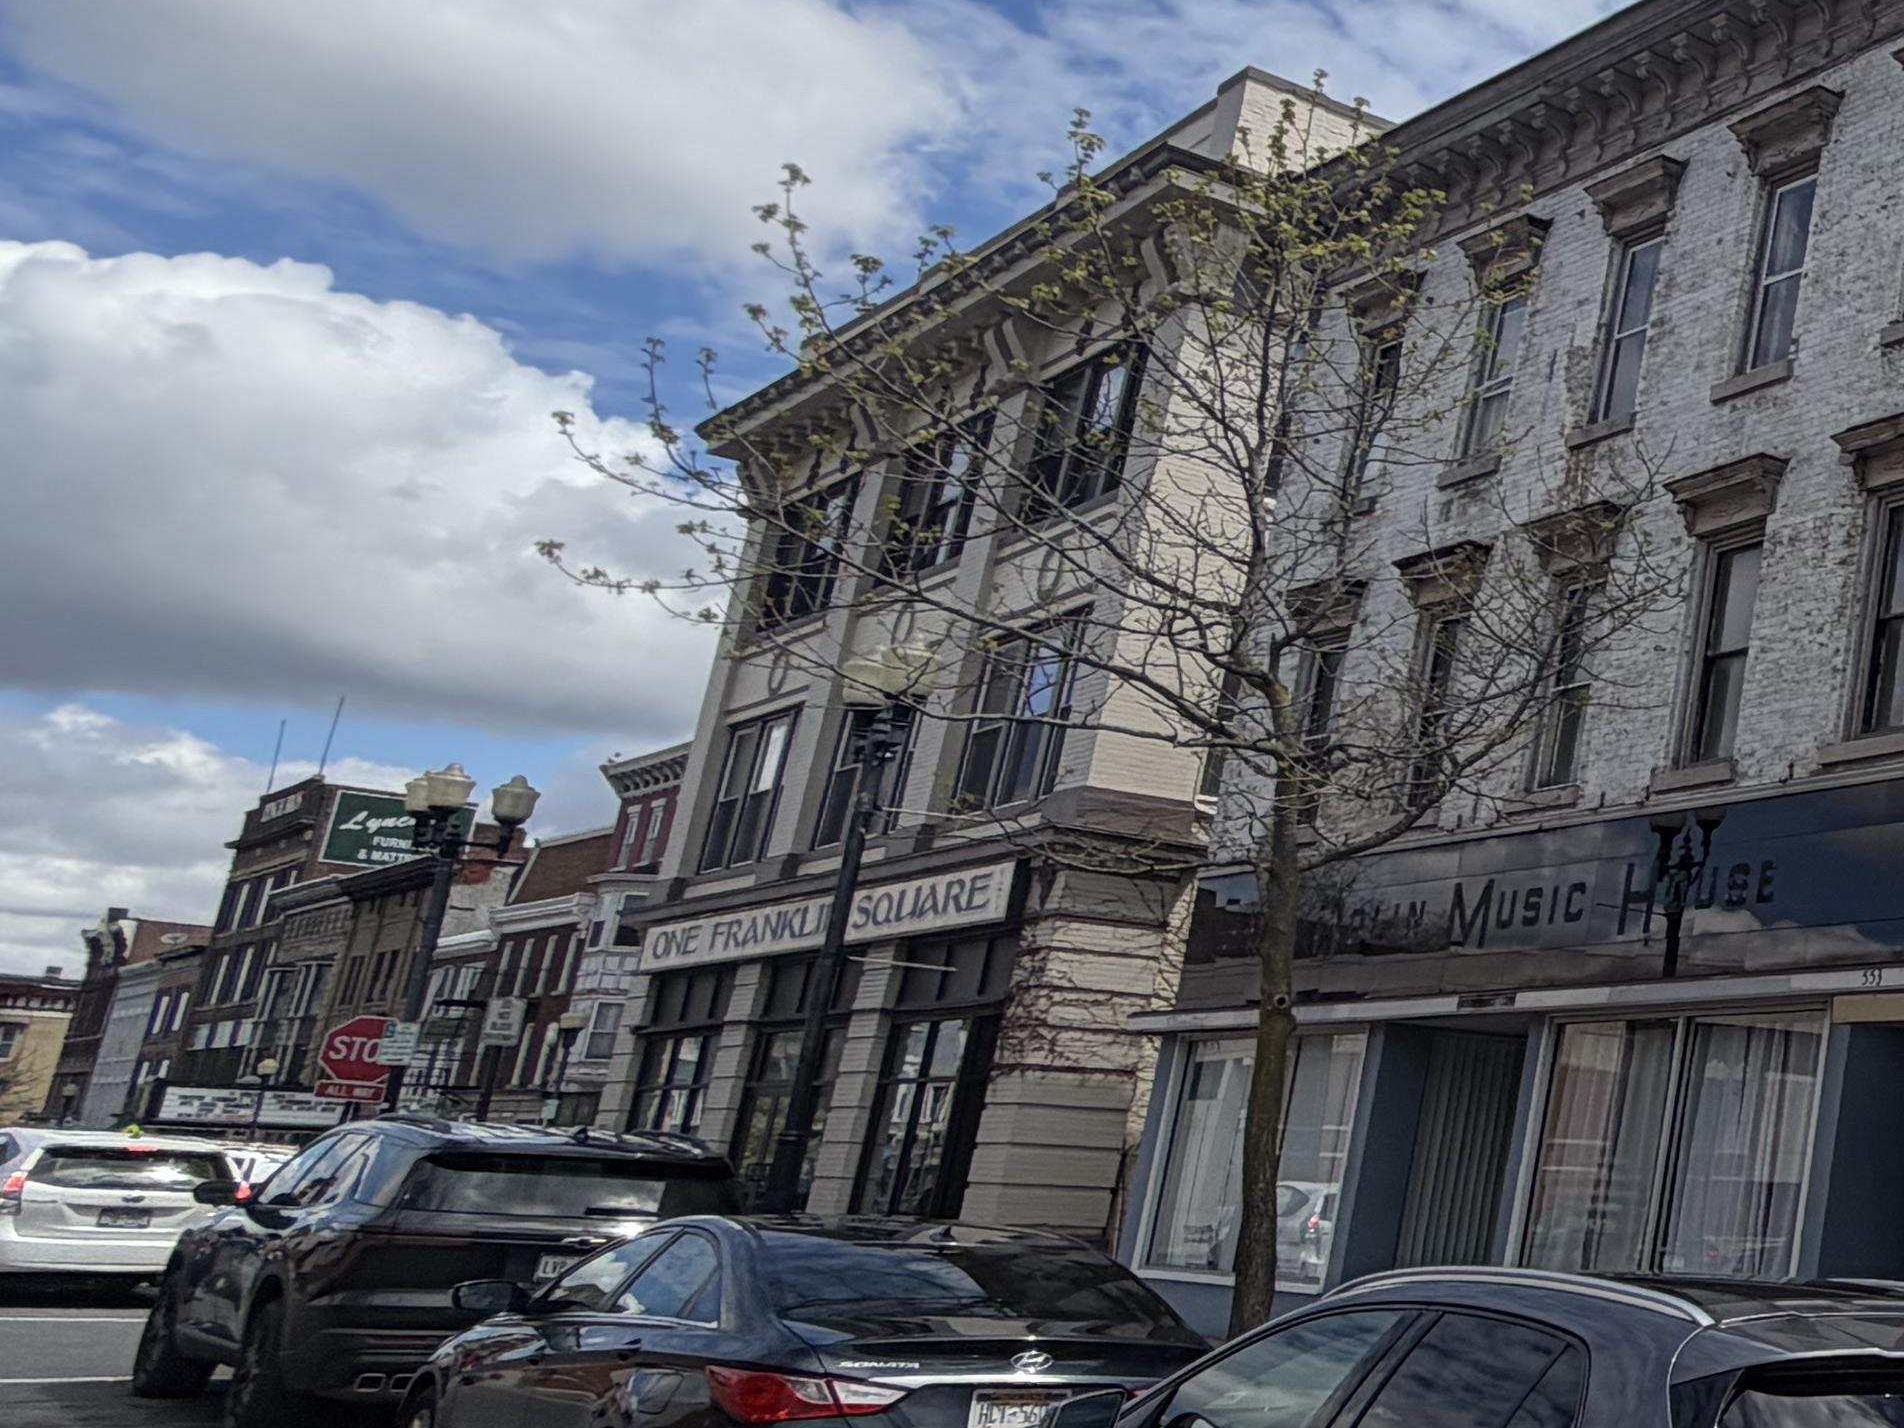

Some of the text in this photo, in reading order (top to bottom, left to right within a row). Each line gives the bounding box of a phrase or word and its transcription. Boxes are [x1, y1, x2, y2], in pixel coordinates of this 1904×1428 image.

[339, 810, 417, 834] Lync
[652, 924, 702, 960] ONE
[708, 902, 830, 952] FRANKLI
[851, 873, 994, 930] SQUARE
[1449, 878, 1587, 949] MUSIC
[328, 1035, 382, 1064] STO
[324, 1084, 347, 1097] ALL
